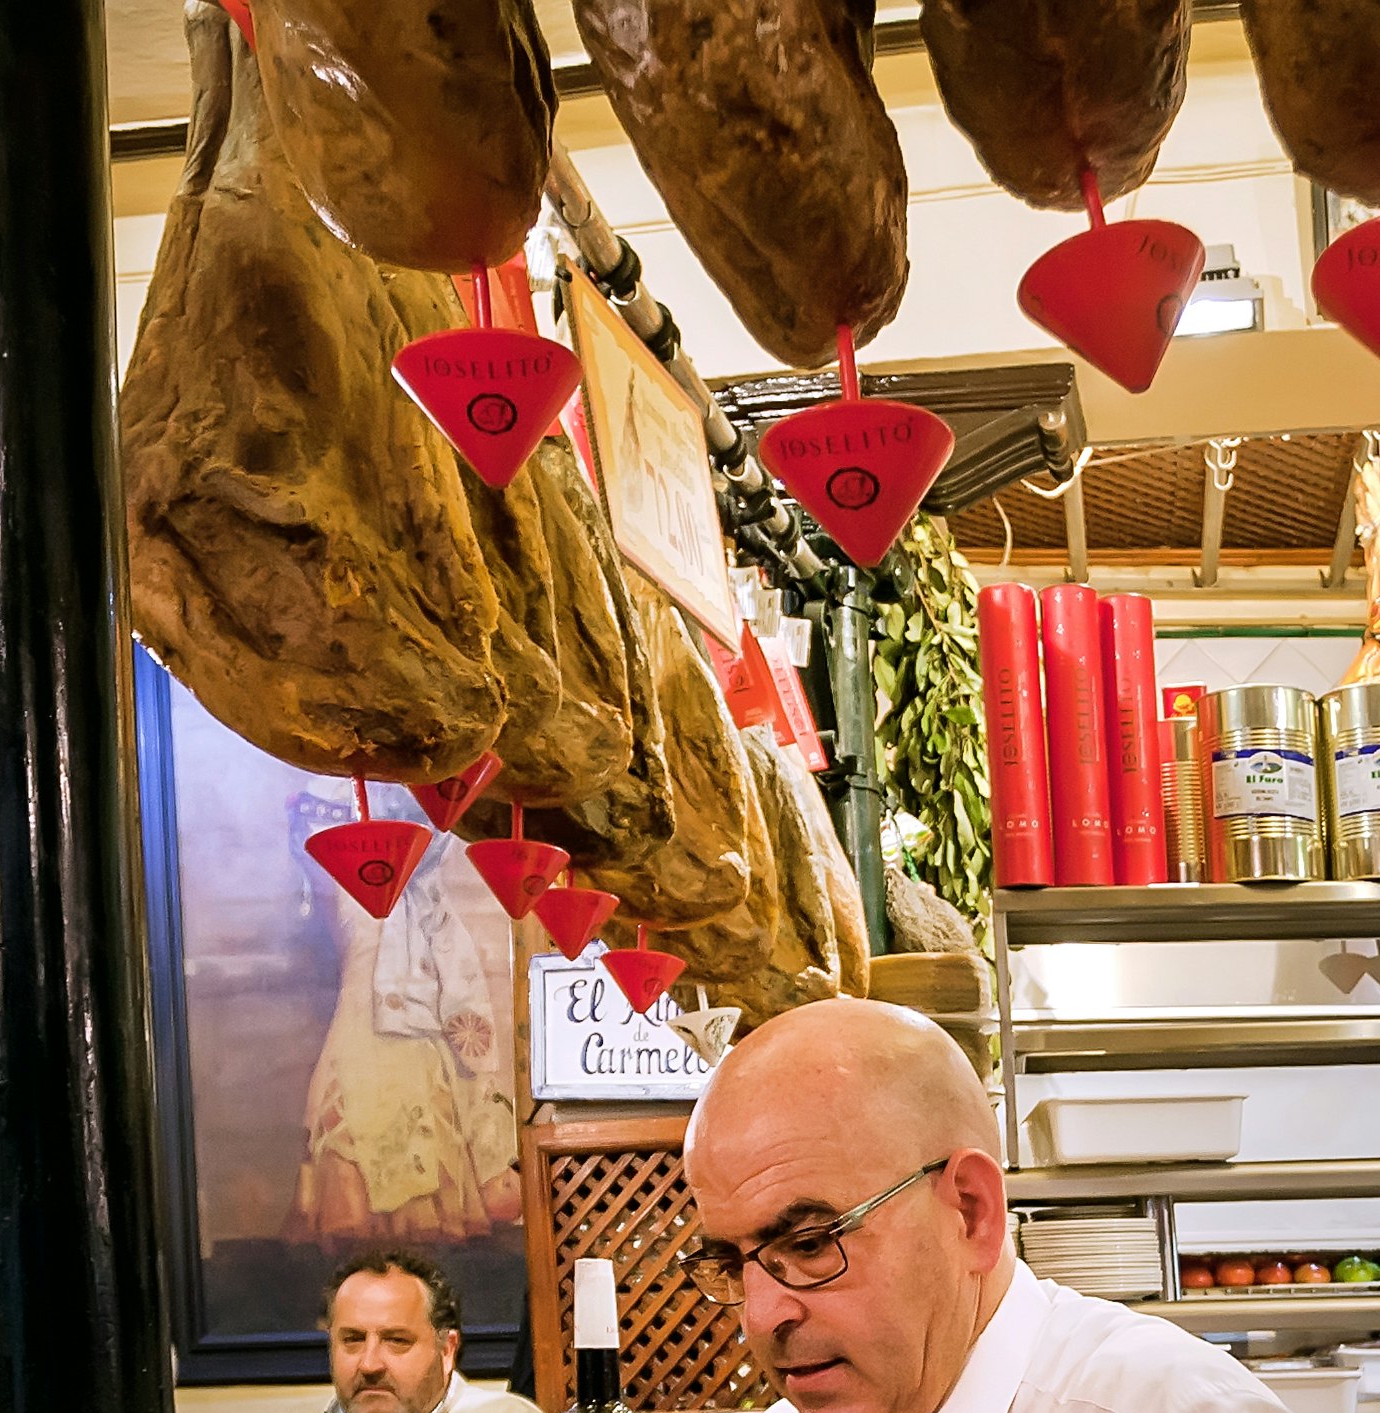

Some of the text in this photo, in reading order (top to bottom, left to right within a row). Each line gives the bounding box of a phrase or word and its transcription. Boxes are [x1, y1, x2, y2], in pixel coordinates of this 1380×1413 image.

[424, 353, 552, 380] JOSELITO
[779, 420, 913, 461] JOSELITO
[1245, 774, 1284, 785] El Faro
[555, 978, 606, 1024] El
[633, 1022, 649, 1042] de
